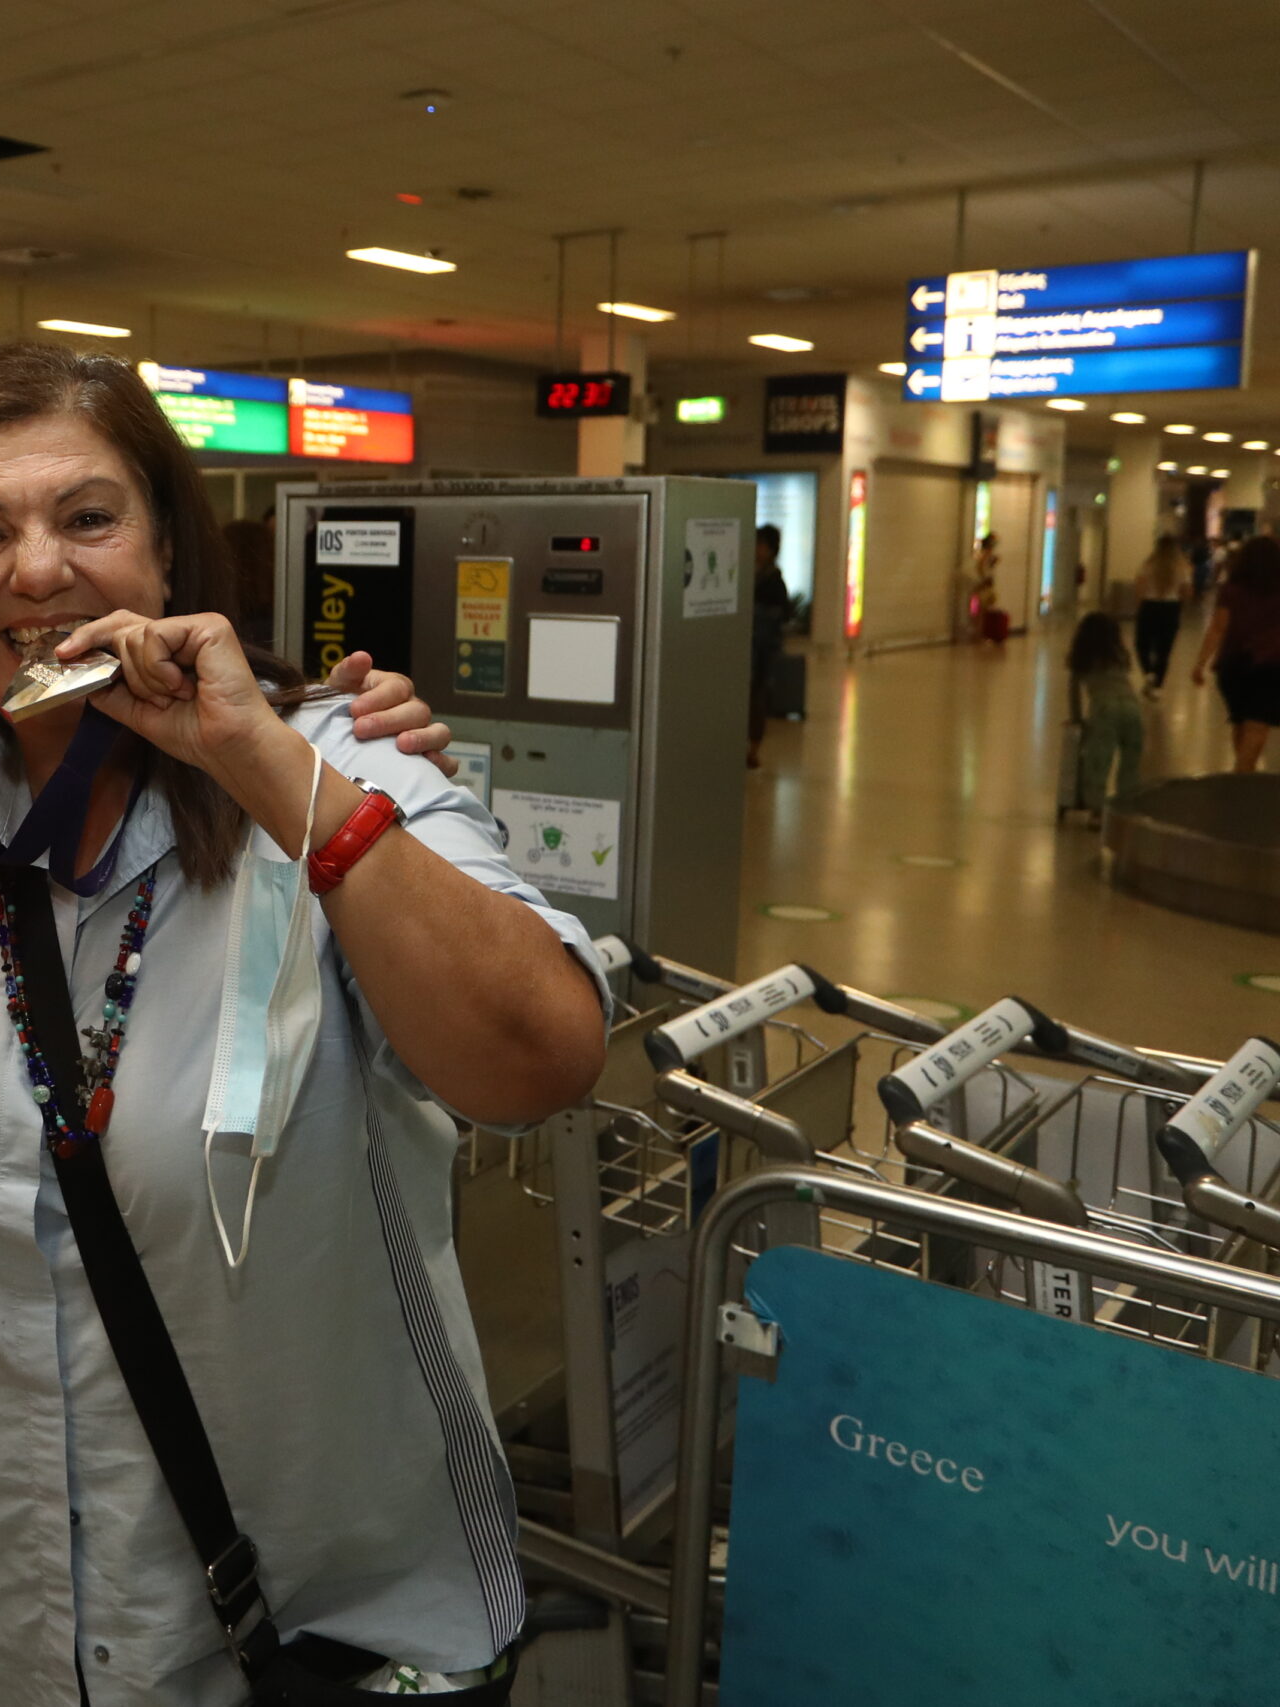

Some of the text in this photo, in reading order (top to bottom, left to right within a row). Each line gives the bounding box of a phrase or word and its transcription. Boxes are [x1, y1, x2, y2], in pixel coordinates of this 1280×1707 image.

[829, 1414, 984, 1493] Greece
[1105, 1513, 1278, 1595] you will
